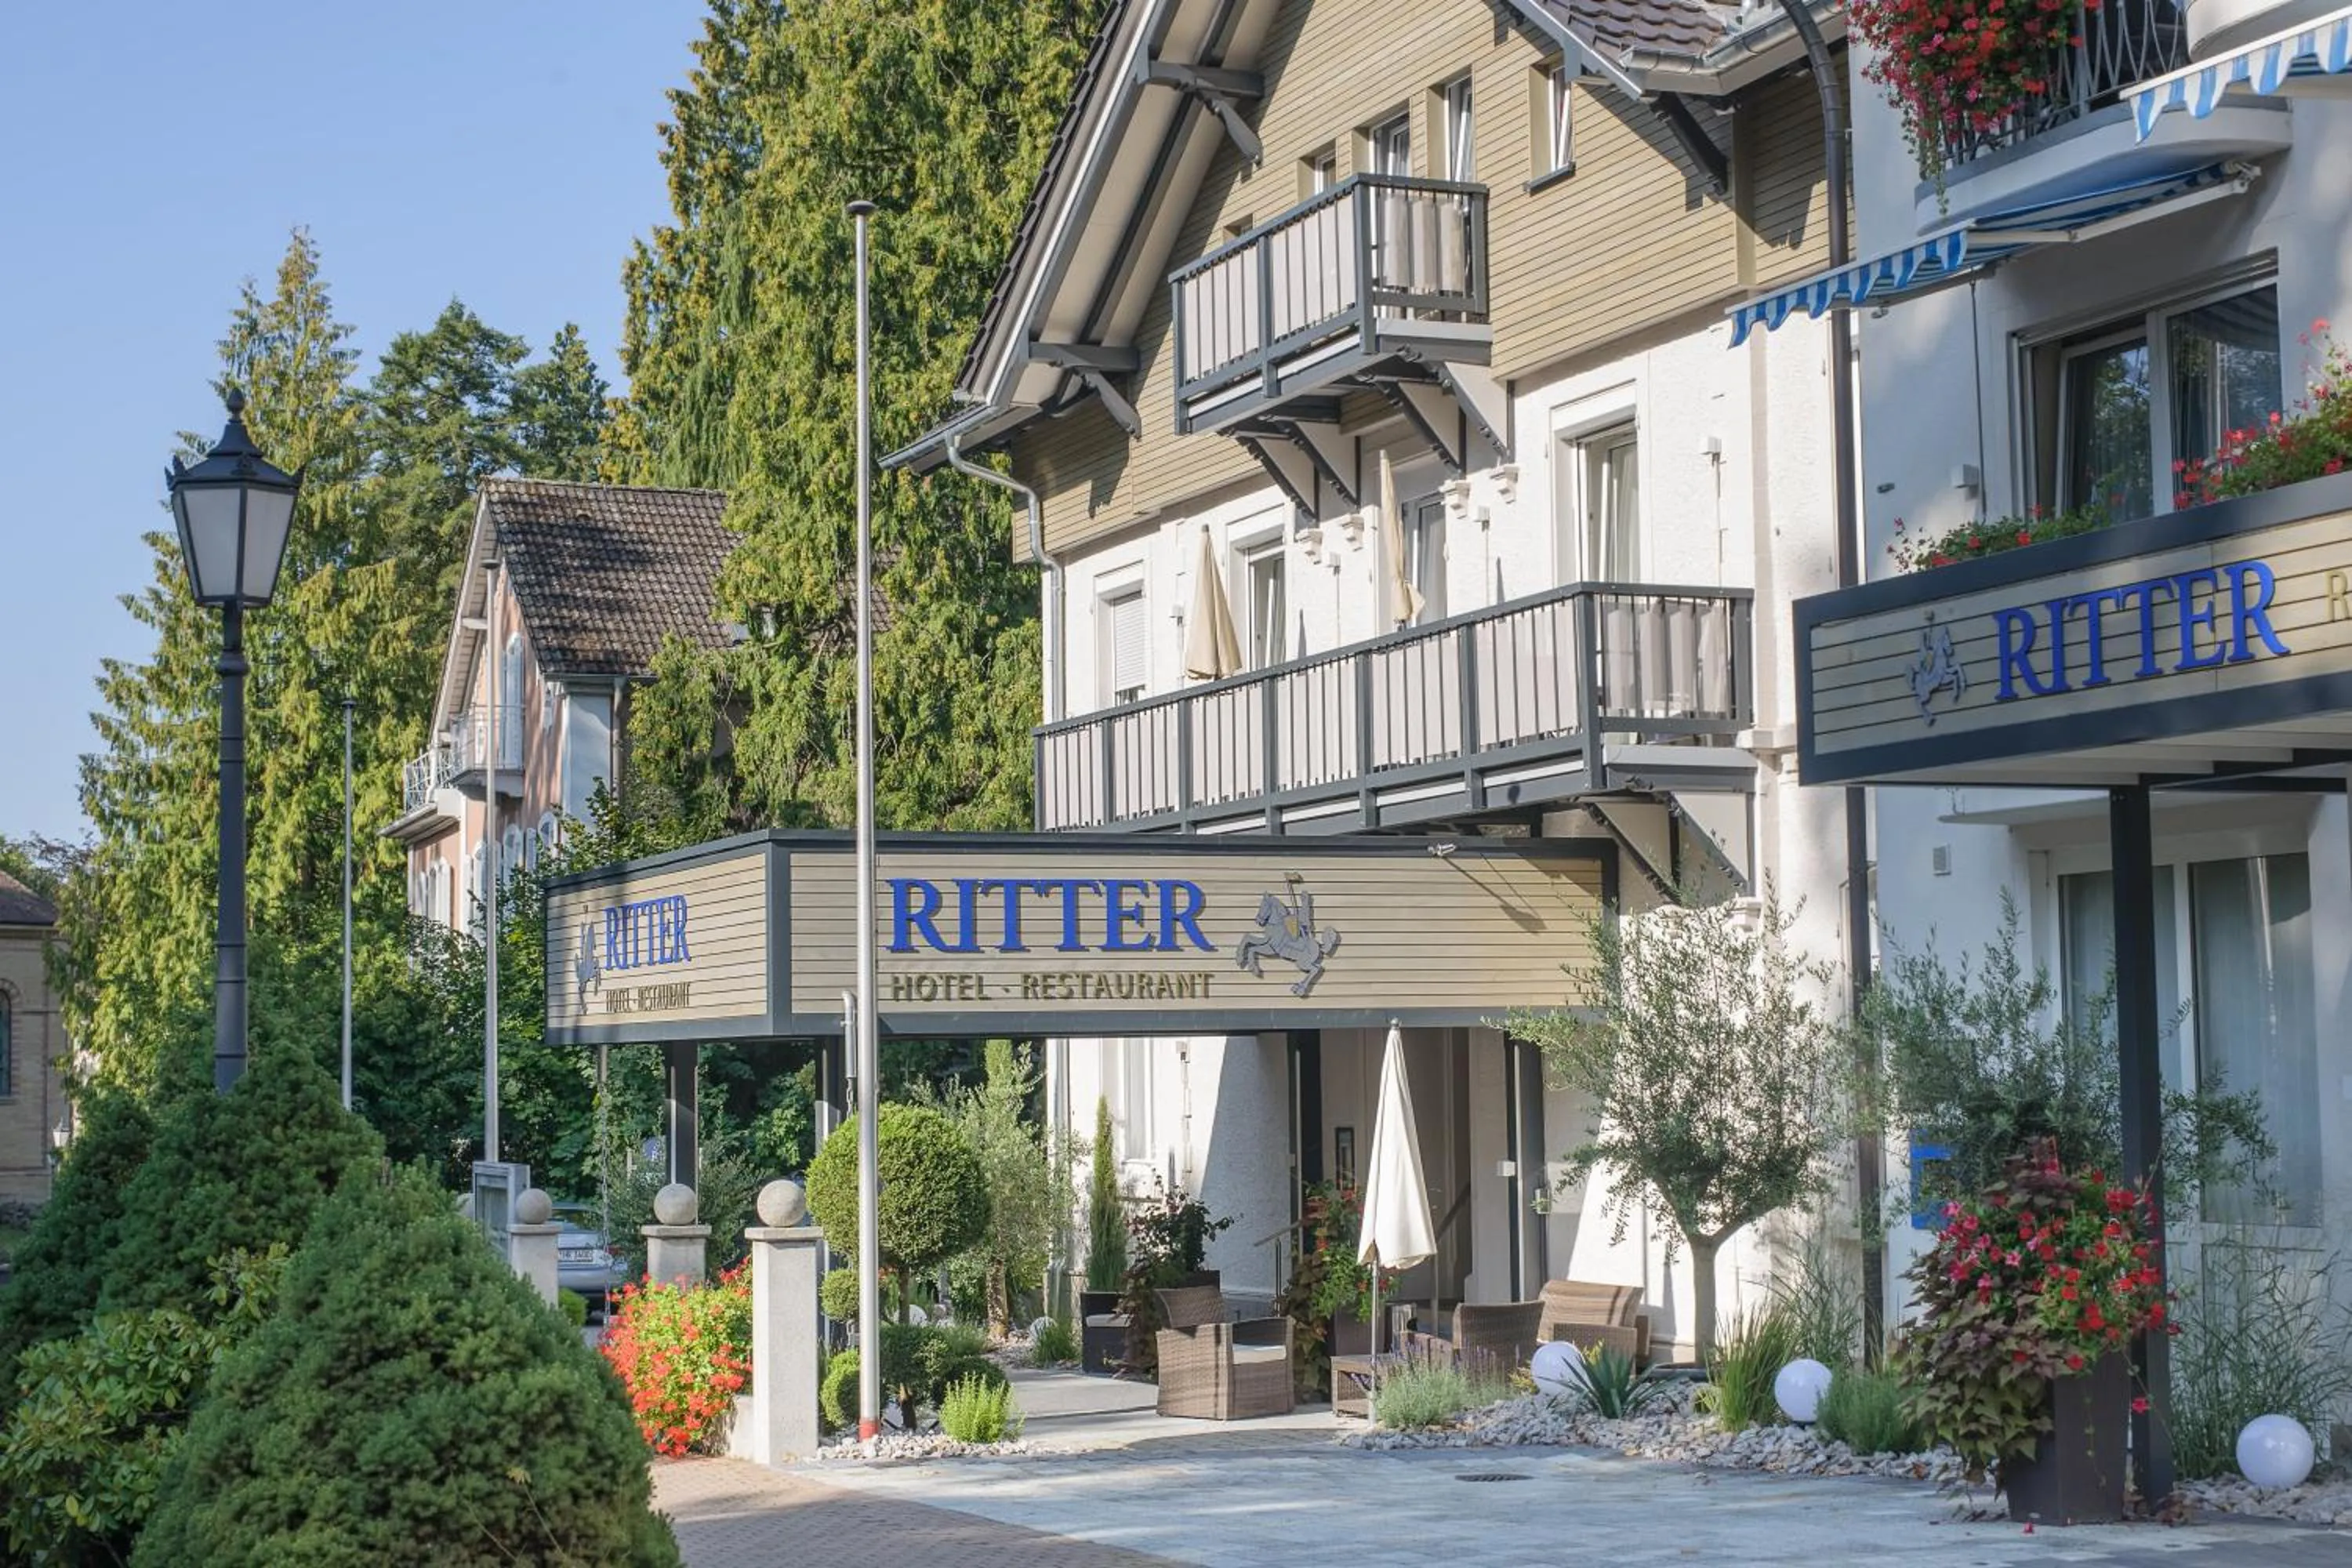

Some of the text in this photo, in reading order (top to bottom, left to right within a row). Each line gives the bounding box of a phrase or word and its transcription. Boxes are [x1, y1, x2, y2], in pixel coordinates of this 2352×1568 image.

[1993, 559, 2290, 701] RITTER
[604, 895, 691, 971] RITTER
[886, 878, 1218, 953] RITTER
[891, 972, 1216, 1002] HOTEL RESTAURANT
